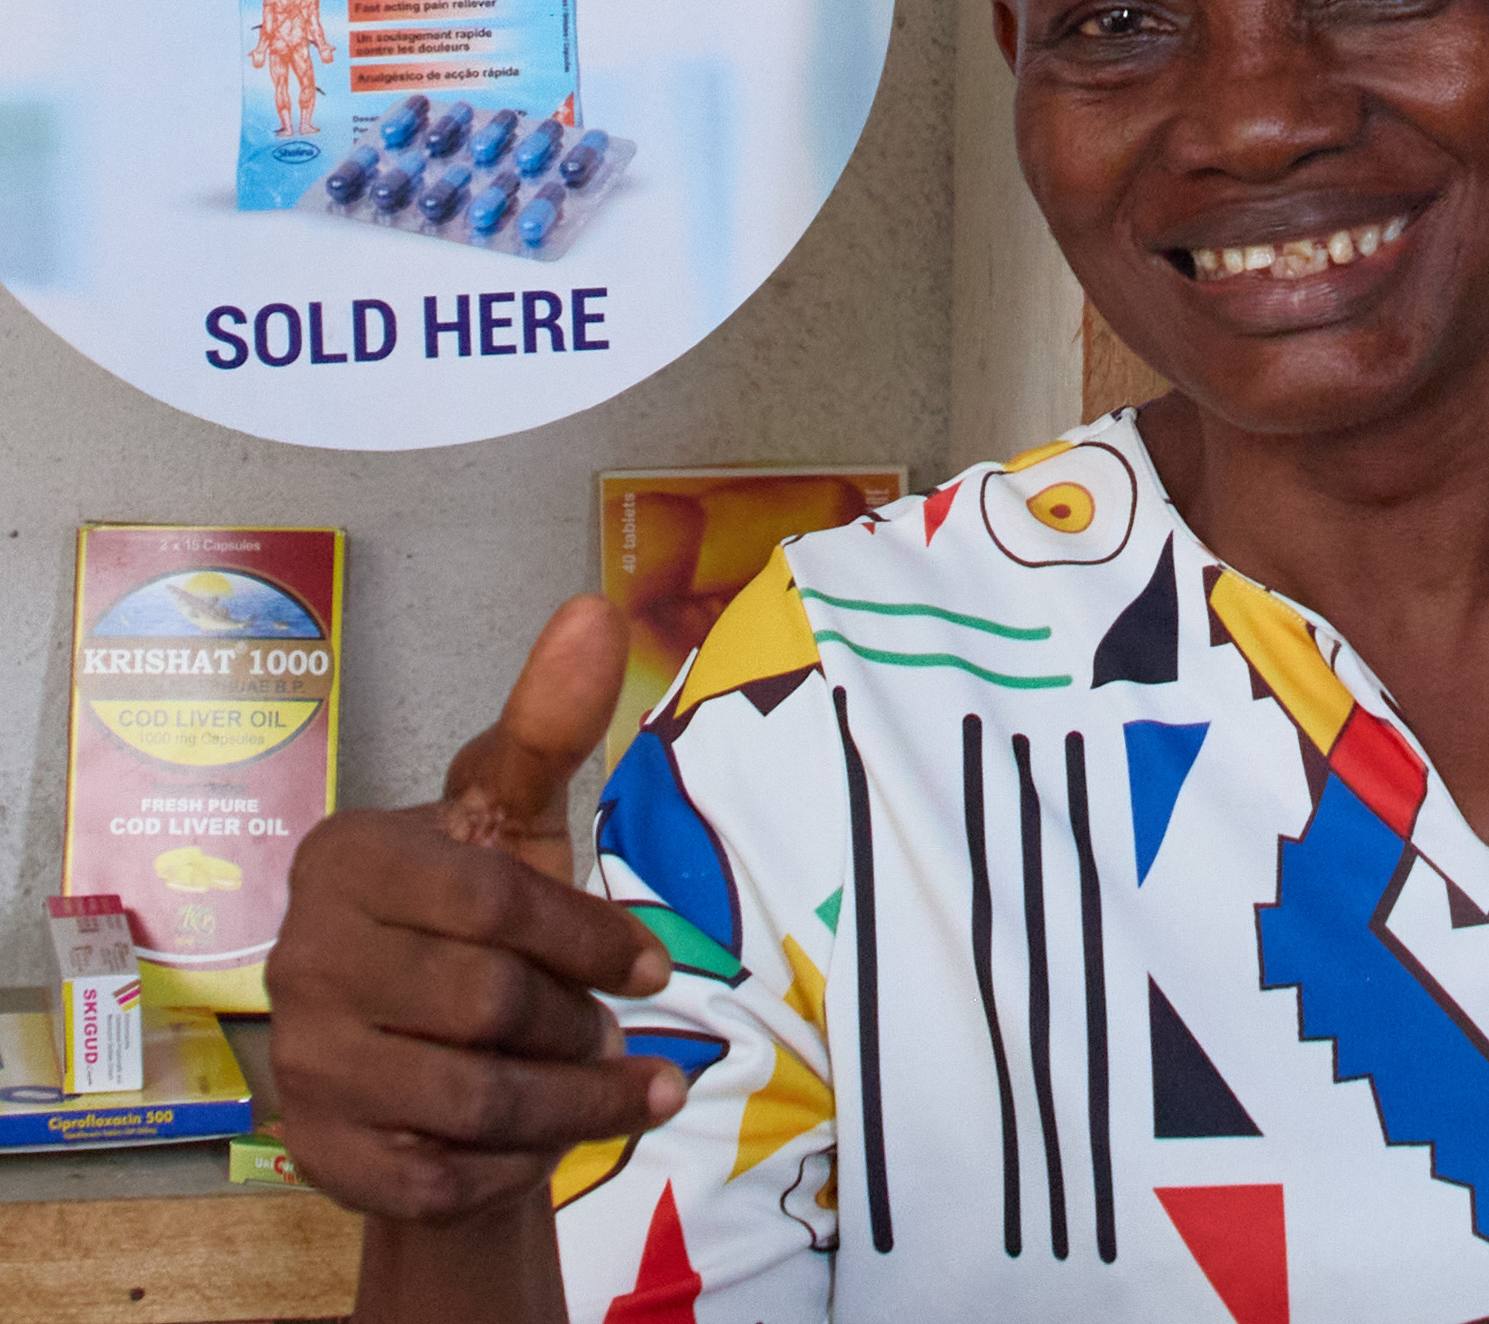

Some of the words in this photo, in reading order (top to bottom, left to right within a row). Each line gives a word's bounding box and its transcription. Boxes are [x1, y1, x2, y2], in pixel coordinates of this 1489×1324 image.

[355, 3, 380, 13] Fast
[384, 1, 420, 13] acting
[424, 0, 448, 12] pain
[452, 0, 497, 9] reliever
[204, 299, 399, 370] SOLD
[423, 288, 610, 359] HERE
[622, 492, 636, 549] tablets
[183, 540, 199, 550] 15
[202, 539, 261, 552] Capsules
[622, 554, 637, 574] 40
[83, 648, 235, 674] KRISHAT
[249, 650, 329, 675] 1000
[118, 710, 168, 728] COD
[176, 710, 241, 728] LIVER
[250, 711, 287, 728] OIL
[141, 799, 201, 813] FRESH
[209, 799, 259, 813] PURE
[110, 817, 161, 835] COD
[169, 817, 241, 836] LIVER
[248, 818, 289, 836] OIL
